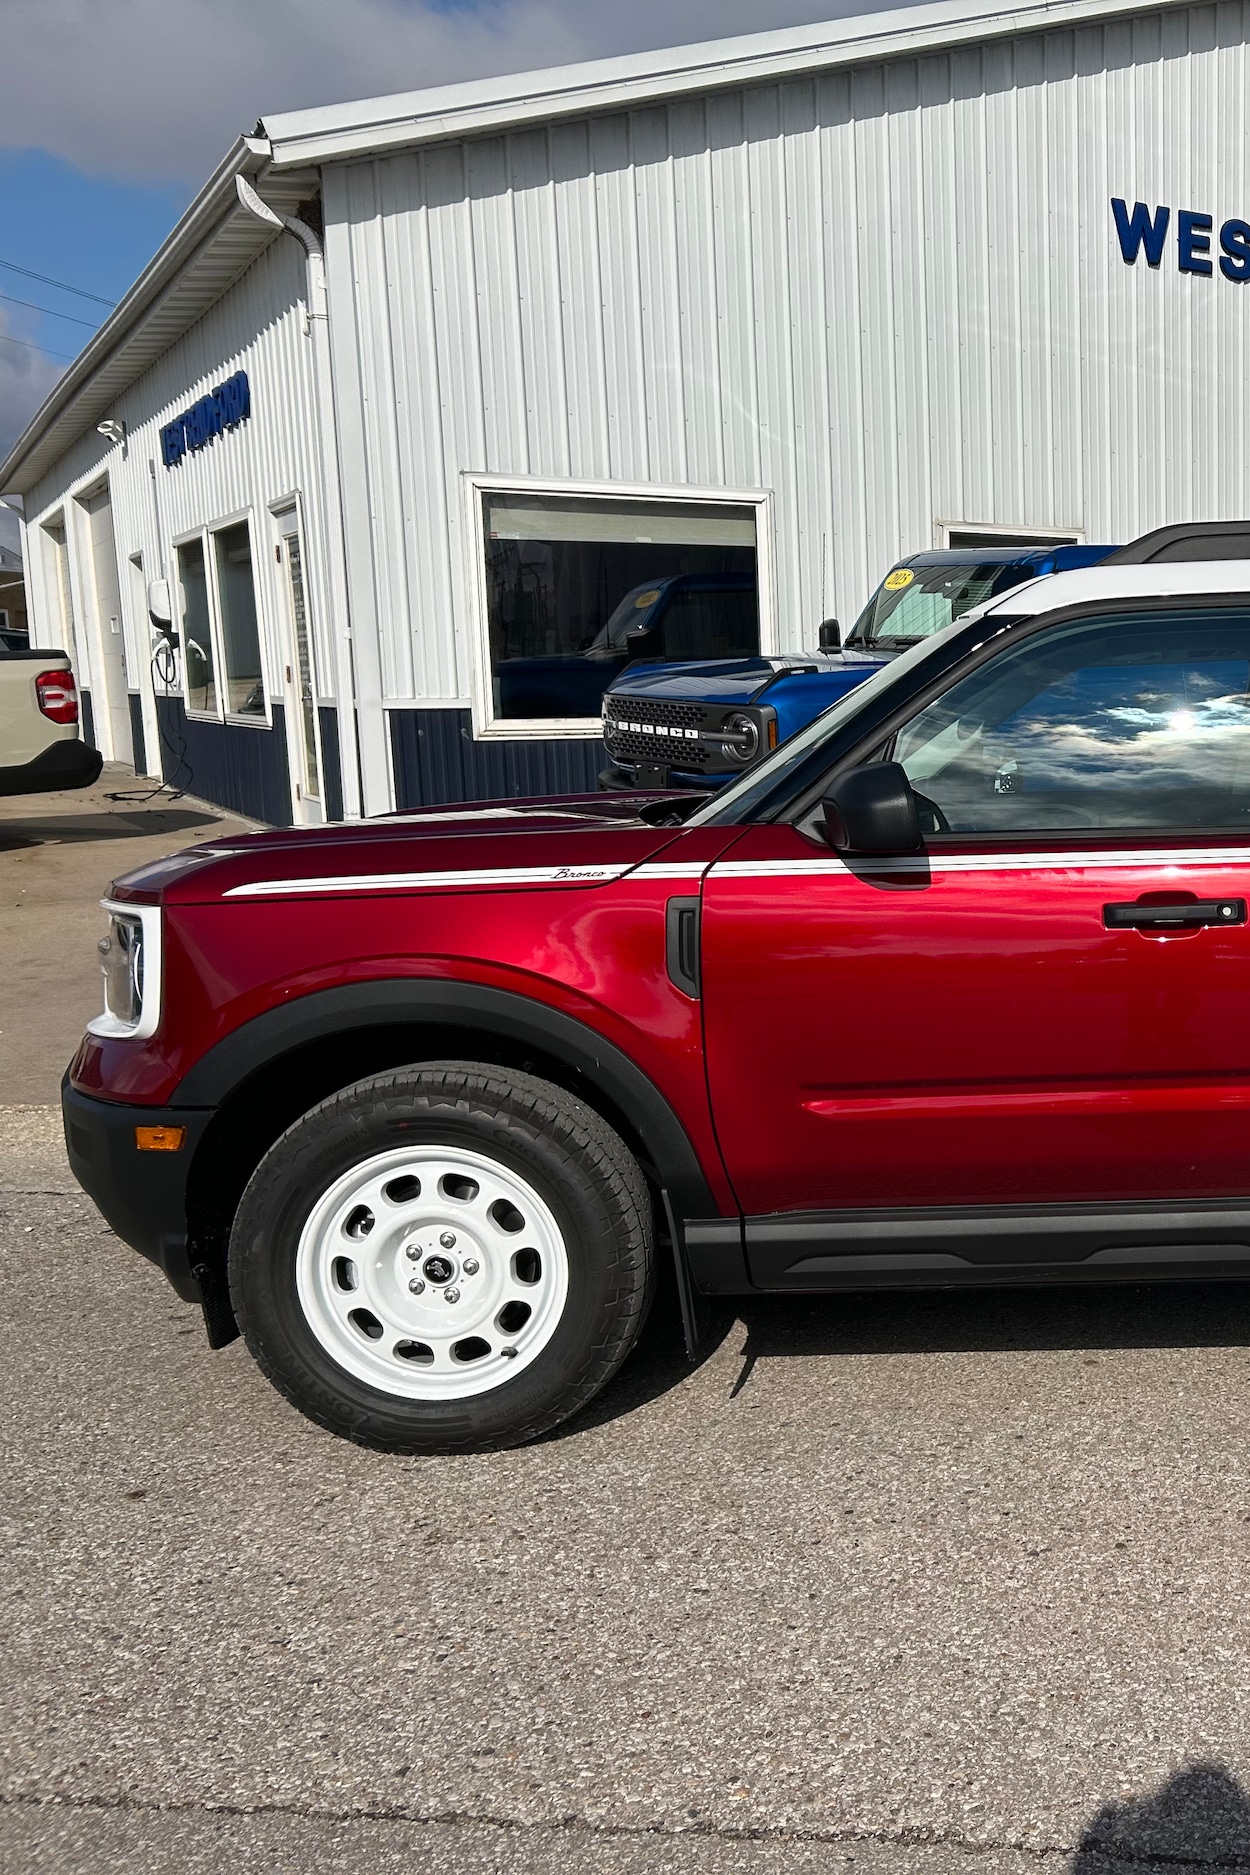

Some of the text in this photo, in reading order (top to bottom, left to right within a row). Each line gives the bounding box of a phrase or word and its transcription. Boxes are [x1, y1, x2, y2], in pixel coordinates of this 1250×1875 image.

[886, 572, 912, 586] 2025
[618, 721, 699, 739] BRONCO
[550, 867, 607, 880] Bronco
